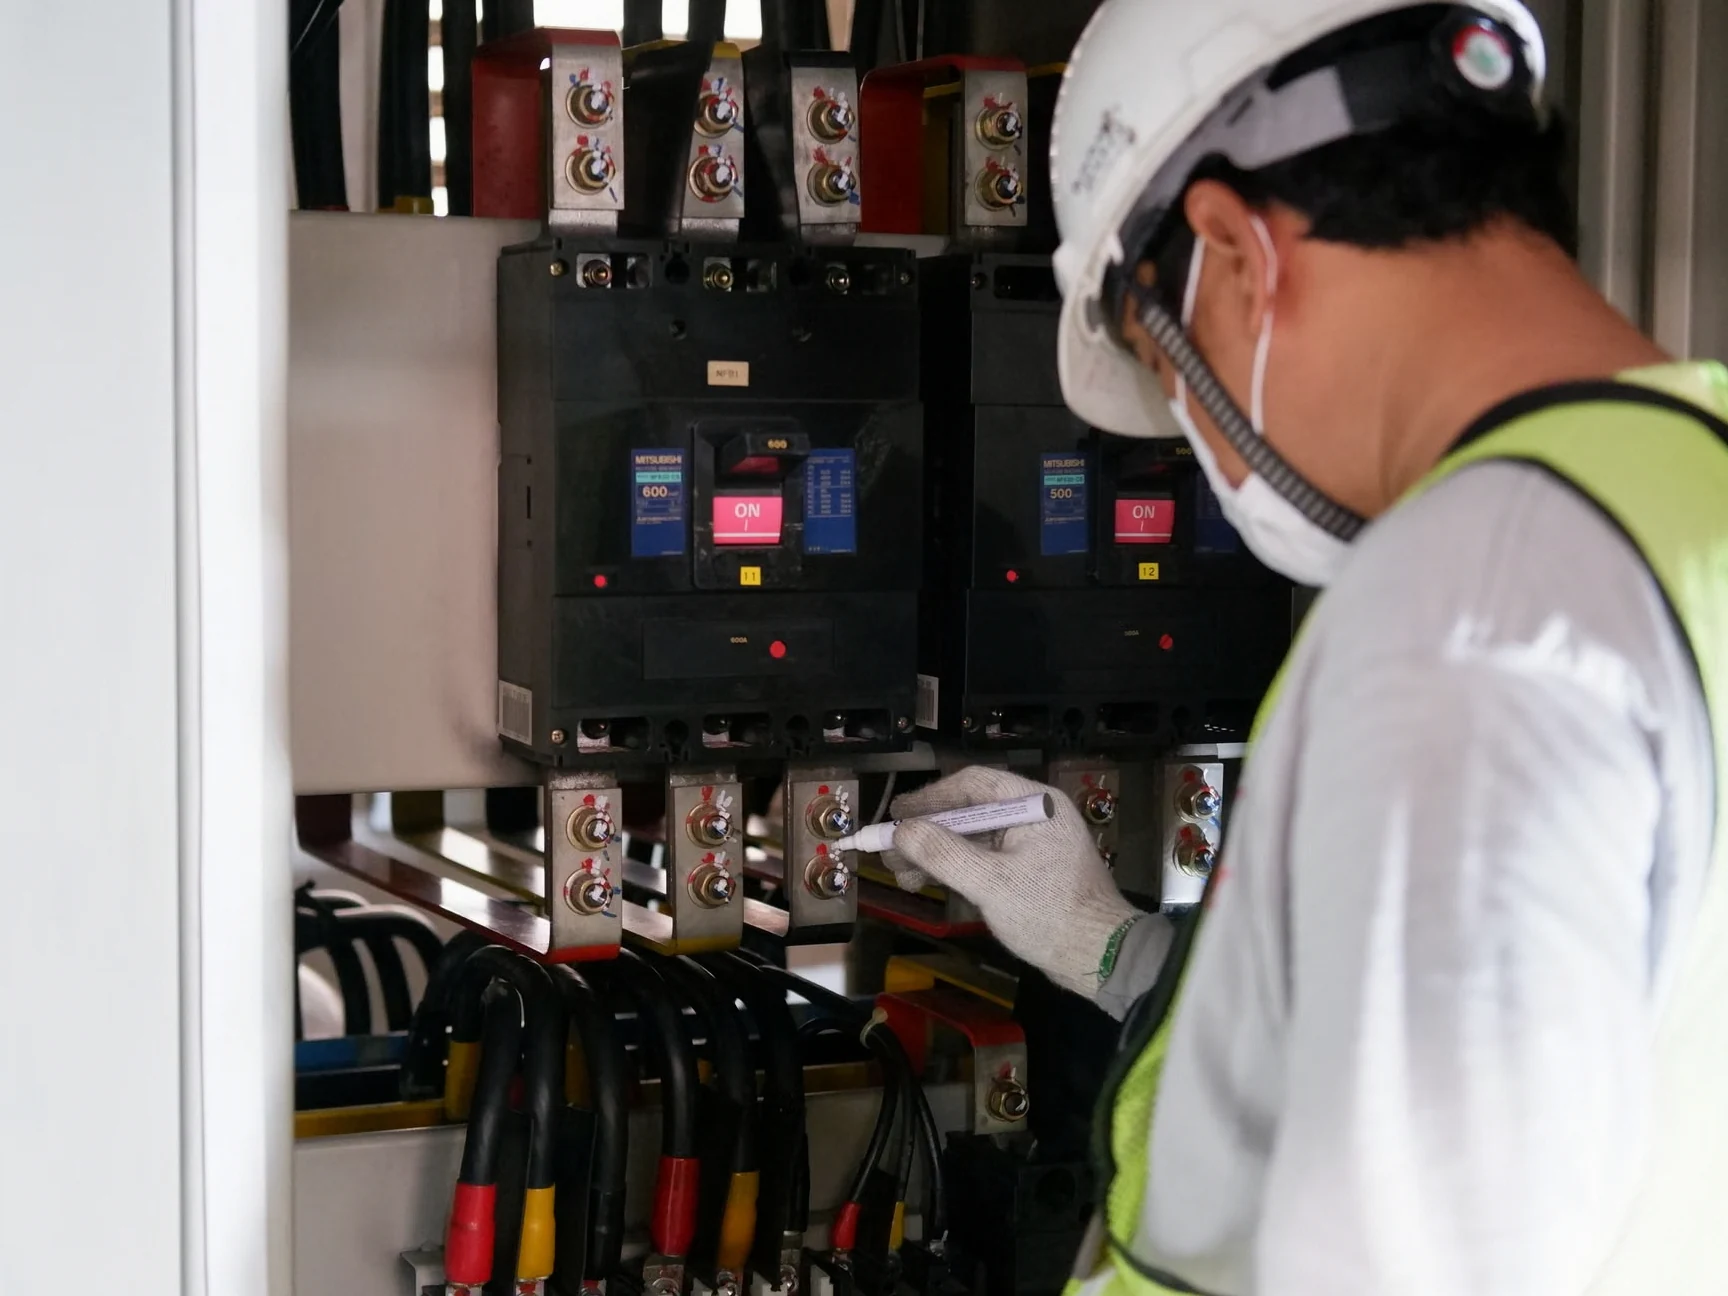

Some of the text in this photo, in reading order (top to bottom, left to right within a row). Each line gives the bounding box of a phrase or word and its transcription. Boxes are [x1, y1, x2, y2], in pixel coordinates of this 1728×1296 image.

[767, 438, 788, 450] 600
[635, 455, 682, 465] MITSUBISHI
[1043, 459, 1085, 468] MITSUBISHI
[642, 485, 668, 498] 600
[1050, 488, 1073, 500] 500
[734, 502, 760, 518] ON
[1132, 505, 1155, 519] ON
[1142, 567, 1155, 577] 12
